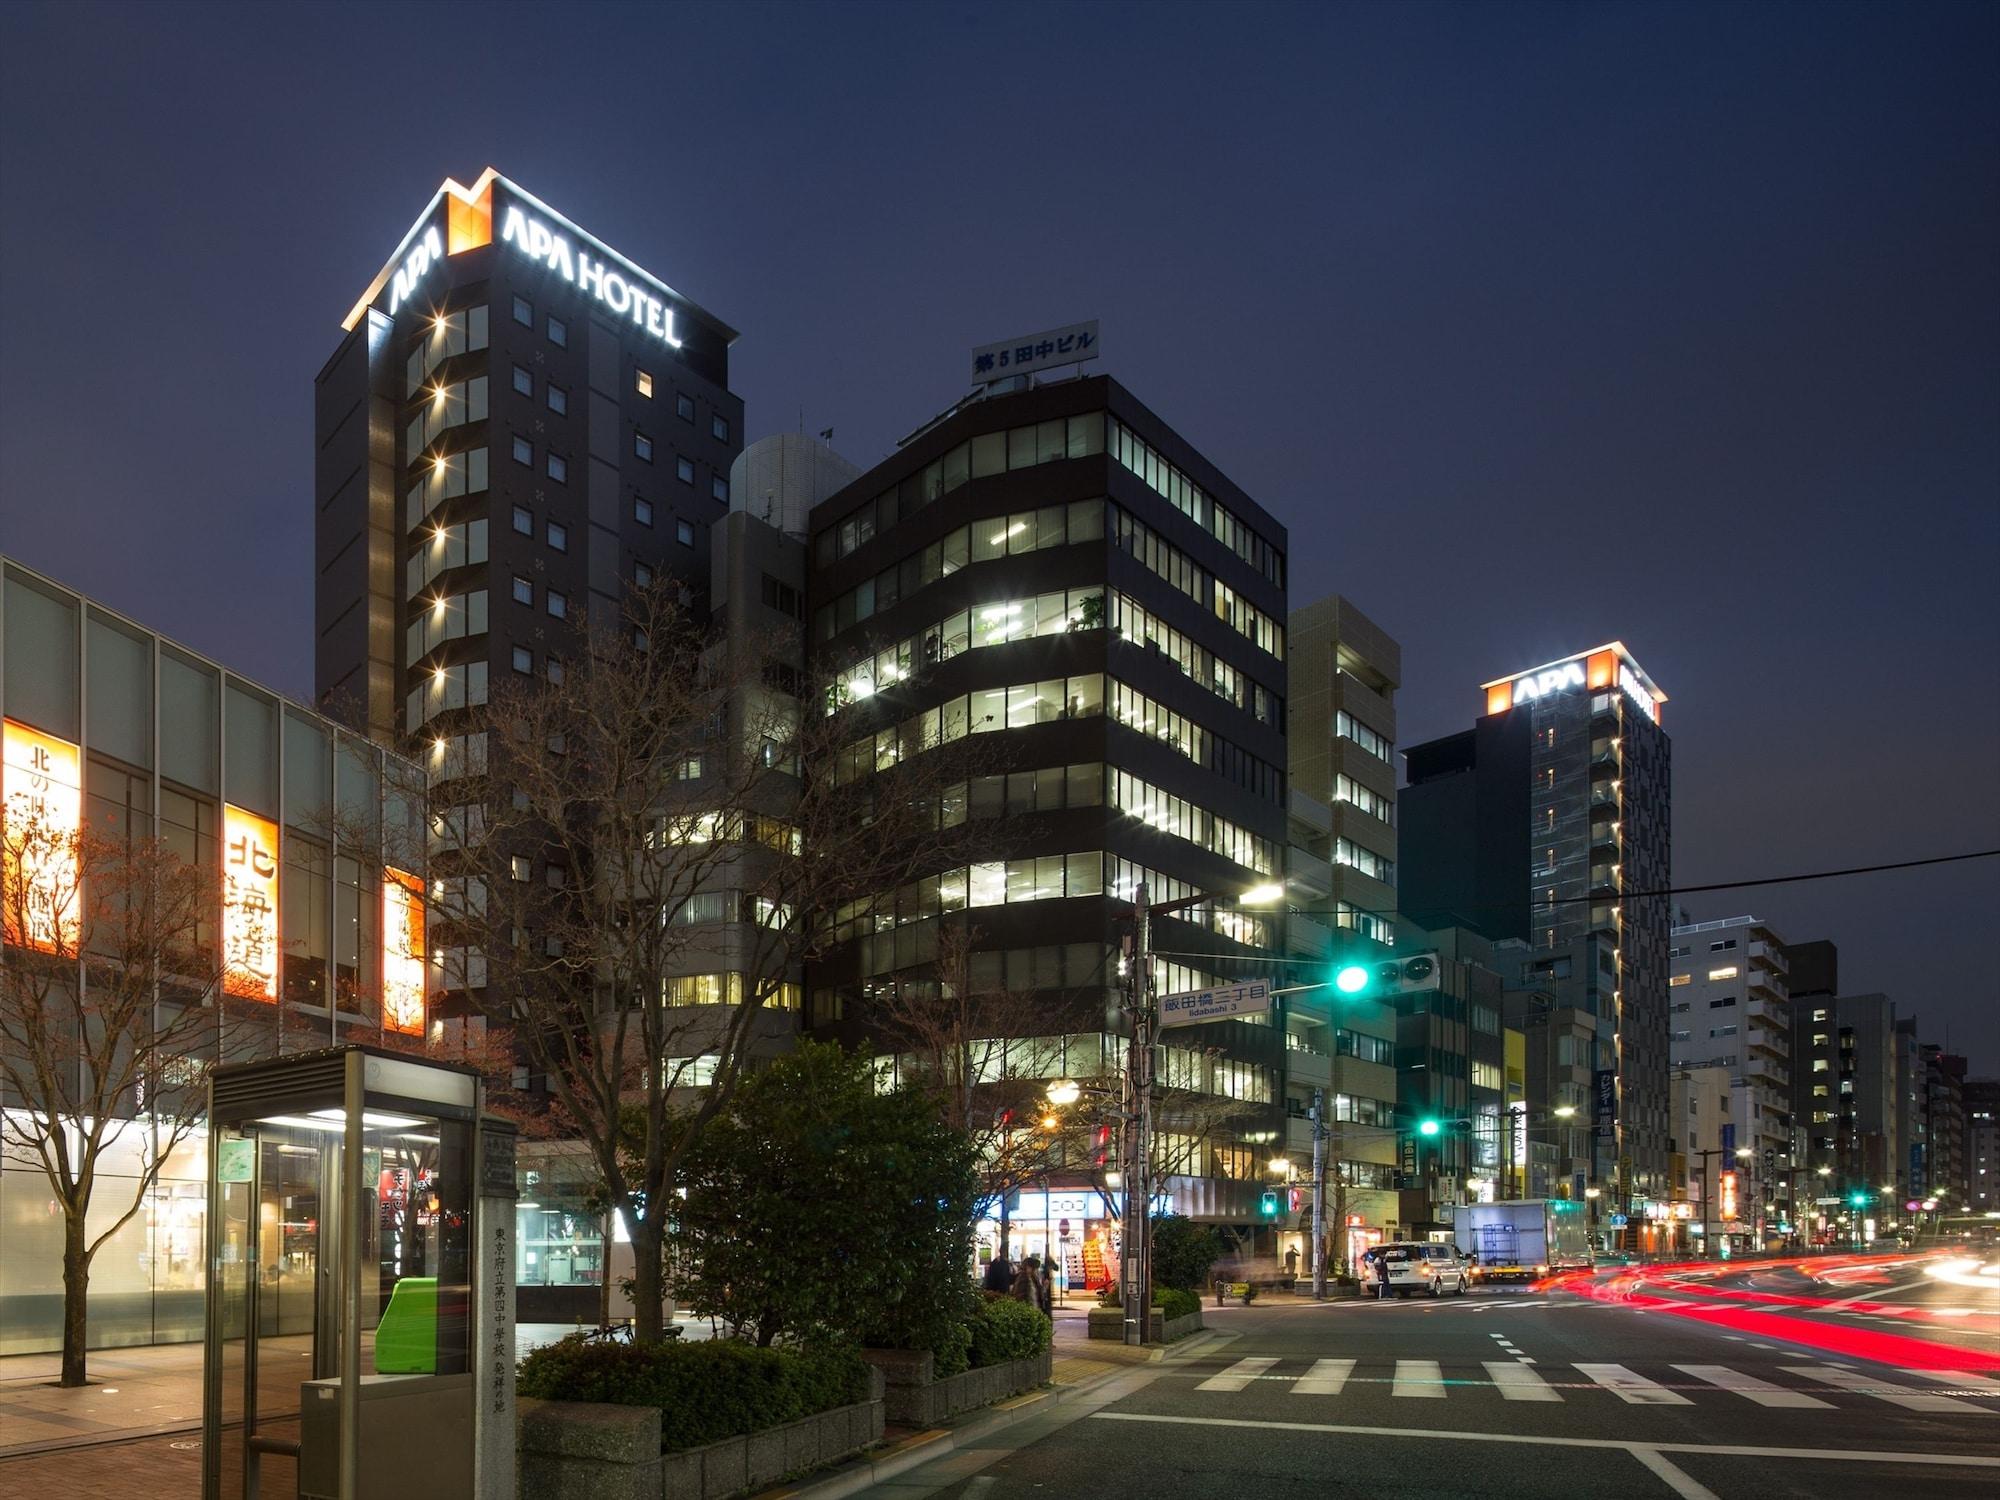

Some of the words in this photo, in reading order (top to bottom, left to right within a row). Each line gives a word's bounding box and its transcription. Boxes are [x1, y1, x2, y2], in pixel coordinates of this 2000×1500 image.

[390, 226, 442, 315] APA
[502, 205, 575, 282] APA
[578, 252, 682, 349] HOTEL
[975, 331, 1097, 375] 第5田中ビル
[1512, 662, 1586, 704] APA
[223, 836, 275, 980] 北海道
[1164, 985, 1265, 1012] 飯田橋三丁目
[1189, 1005, 1228, 1017] Iidabashi
[1231, 1003, 1237, 1011] 3
